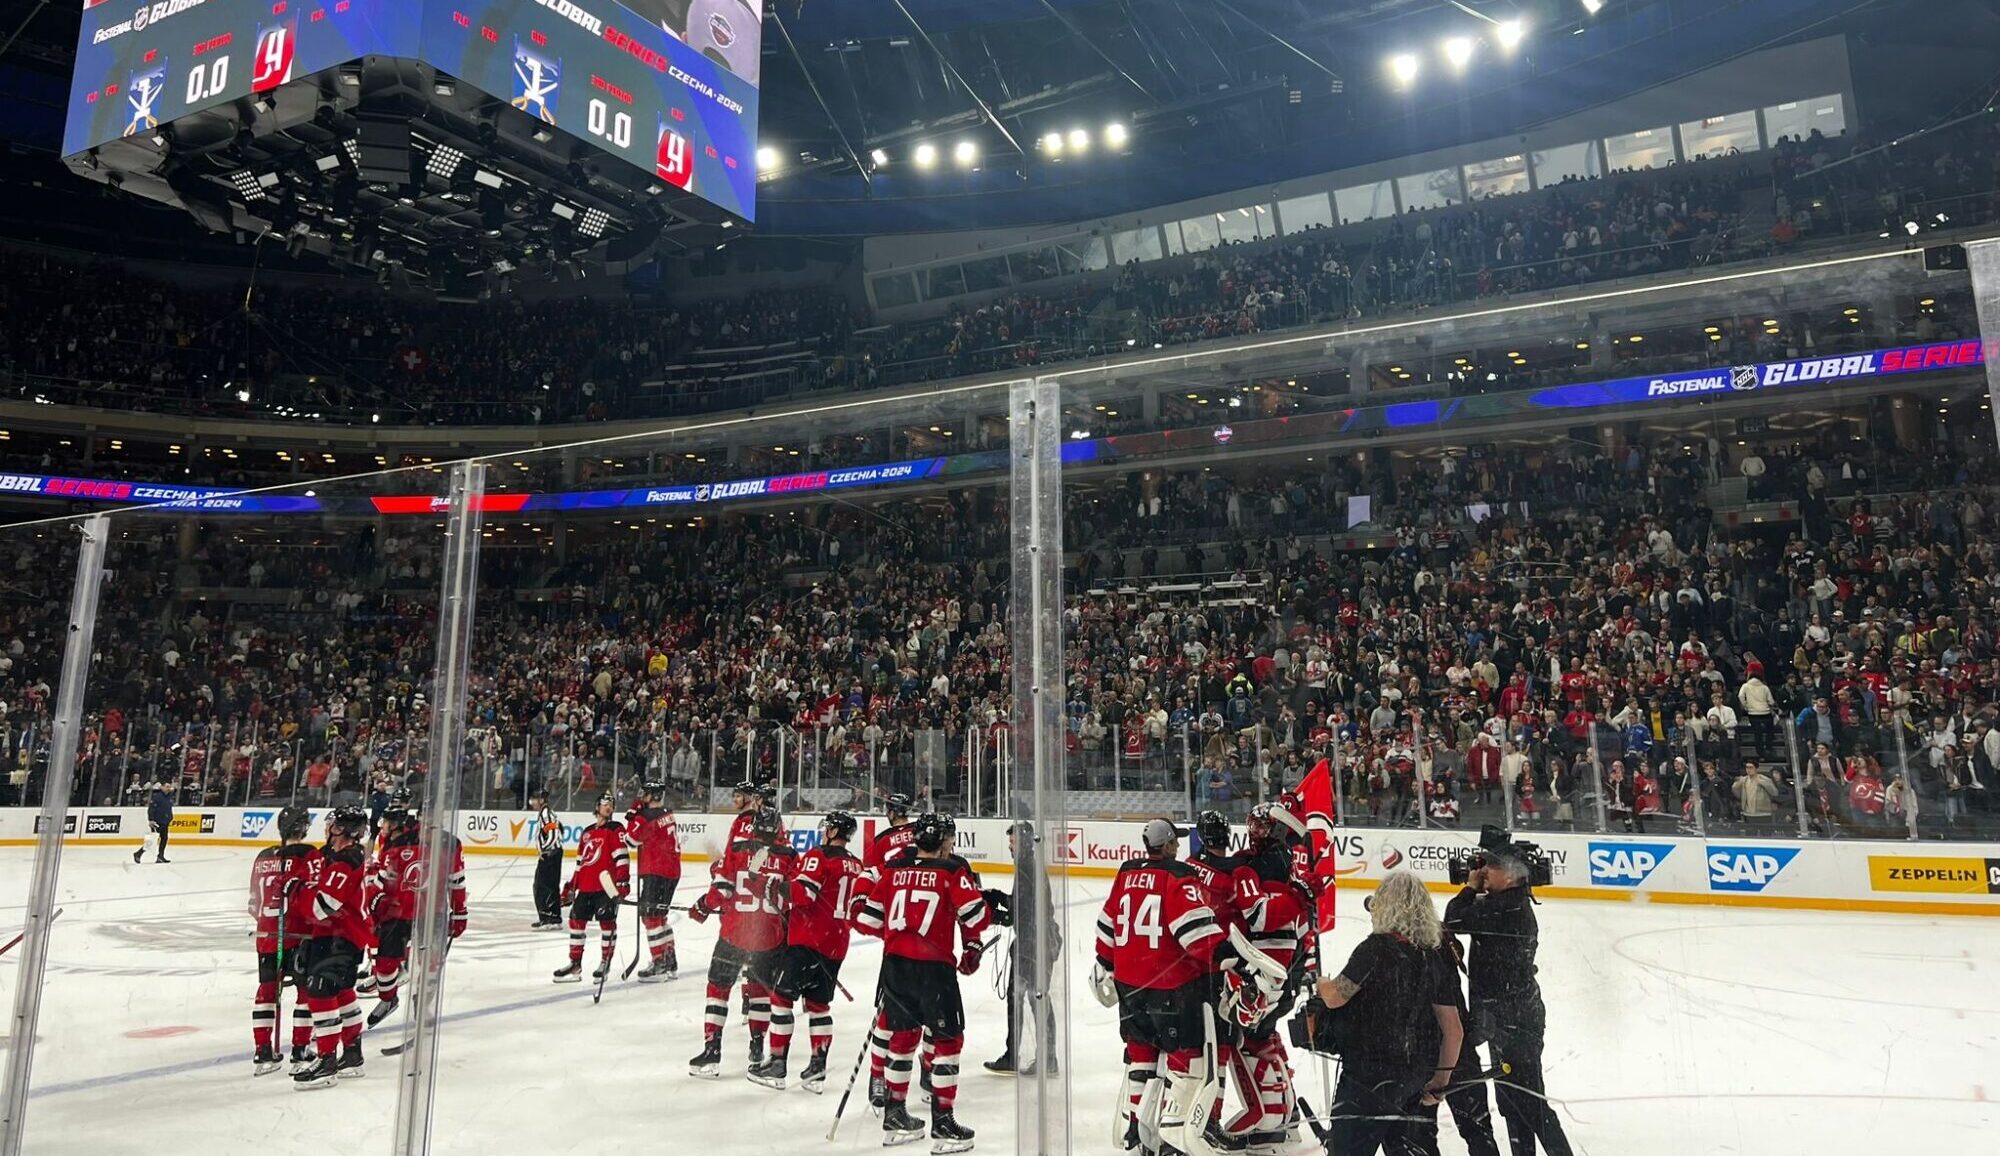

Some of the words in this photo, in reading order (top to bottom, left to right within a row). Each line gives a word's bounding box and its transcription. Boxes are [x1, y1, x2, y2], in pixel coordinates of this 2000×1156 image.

[533, 0, 602, 37] LOBAL
[603, 25, 668, 73] SERIES
[186, 55, 229, 104] 0.0
[588, 98, 631, 148] 0.0
[1648, 376, 1725, 396] FASTENAL
[1763, 354, 1877, 386] GLOBAL
[0, 475, 41, 491] BAL
[44, 479, 130, 498] SERIES
[646, 490, 692, 502] FASTENAL
[711, 480, 765, 499] GLOBAL
[768, 473, 827, 493] SERIES
[88, 823, 117, 831] SPORT
[242, 816, 266, 834] SAP
[467, 815, 498, 832] aws
[677, 824, 707, 833] NVEST
[740, 822, 754, 835] 14
[890, 831, 914, 846] MEIER
[801, 857, 820, 872] 18
[1410, 860, 1426, 871] ICE
[1590, 850, 1655, 879] SAP
[1709, 853, 1779, 884] SAP
[325, 871, 348, 889] 17
[893, 870, 937, 887] COTTER
[1124, 873, 1155, 890] ALLEN
[1241, 879, 1260, 897] 11
[888, 889, 940, 937] 47
[1115, 893, 1163, 949] 34
